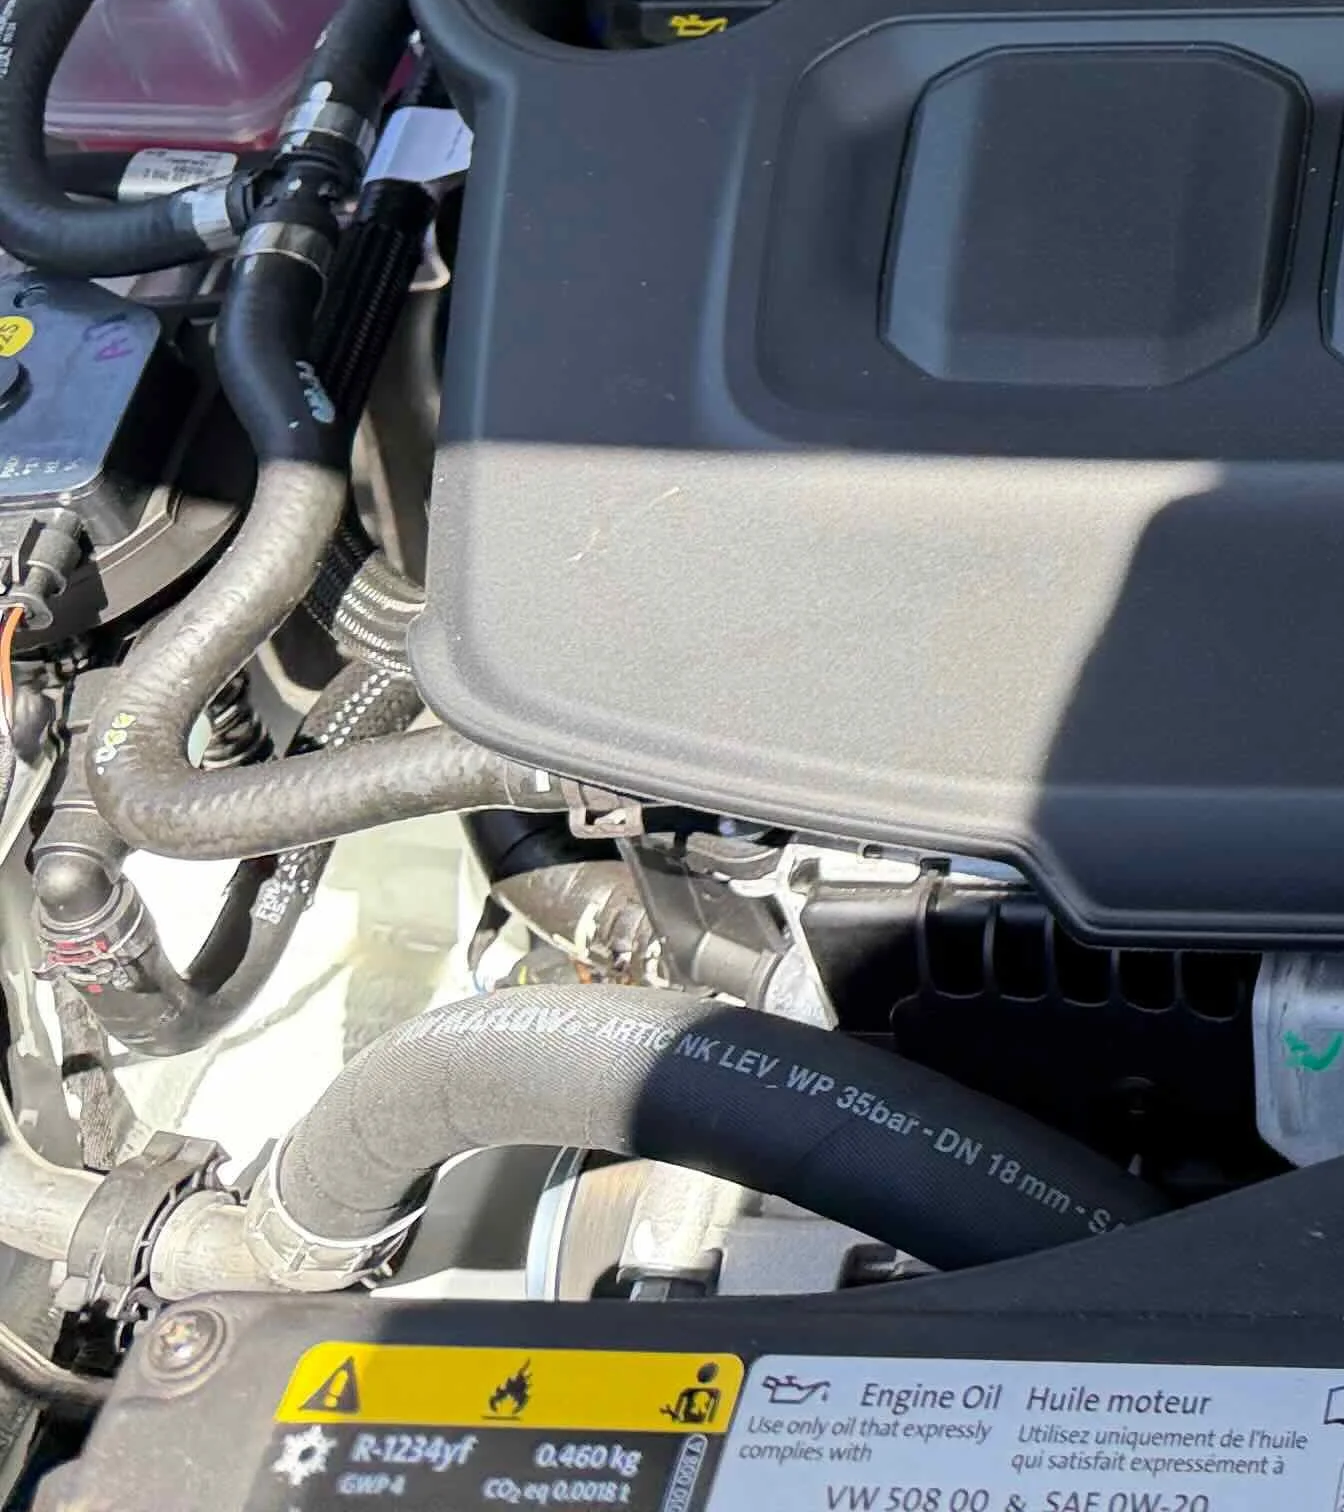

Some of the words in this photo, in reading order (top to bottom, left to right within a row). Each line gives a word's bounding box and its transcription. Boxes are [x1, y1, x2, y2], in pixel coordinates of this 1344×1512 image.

[597, 1015, 675, 1050] ARTIC
[676, 1033, 720, 1062] NK
[720, 1045, 780, 1079] LEV
[785, 1064, 836, 1095] WP
[836, 1086, 919, 1135] 35bar
[934, 1127, 983, 1166] DN
[988, 1153, 1021, 1184] 18
[1017, 1173, 1070, 1213] mm
[1088, 1209, 1125, 1234] S
[861, 1383, 955, 1415] Engine
[962, 1383, 1003, 1410] Oil
[1025, 1386, 1100, 1413] Huile
[1106, 1389, 1212, 1416] moteur
[747, 1416, 783, 1435] Use
[787, 1418, 827, 1440] only
[831, 1417, 856, 1437] oil
[859, 1419, 898, 1438] that
[902, 1420, 992, 1444] expressly
[1018, 1424, 1090, 1444] Utilisez
[1095, 1426, 1216, 1451] uniquement
[1220, 1428, 1244, 1448] de
[1248, 1429, 1308, 1450] l'huile
[352, 1434, 479, 1472] R-1234yf
[535, 1442, 607, 1469] 0.460
[609, 1444, 643, 1478] kg
[738, 1443, 824, 1466] complies
[829, 1444, 873, 1462] with
[1011, 1450, 1043, 1475] qui
[1048, 1451, 1125, 1471] satisfait
[1130, 1453, 1268, 1478] expressément
[1272, 1455, 1285, 1474] à
[336, 1471, 386, 1494] GWP
[523, 1483, 549, 1505] eq
[826, 1485, 881, 1511] VW
[884, 1487, 942, 1512] 508
[950, 1488, 990, 1512] 00
[1004, 1493, 1027, 1512] &
[1107, 1491, 1209, 1512] 0W-20
